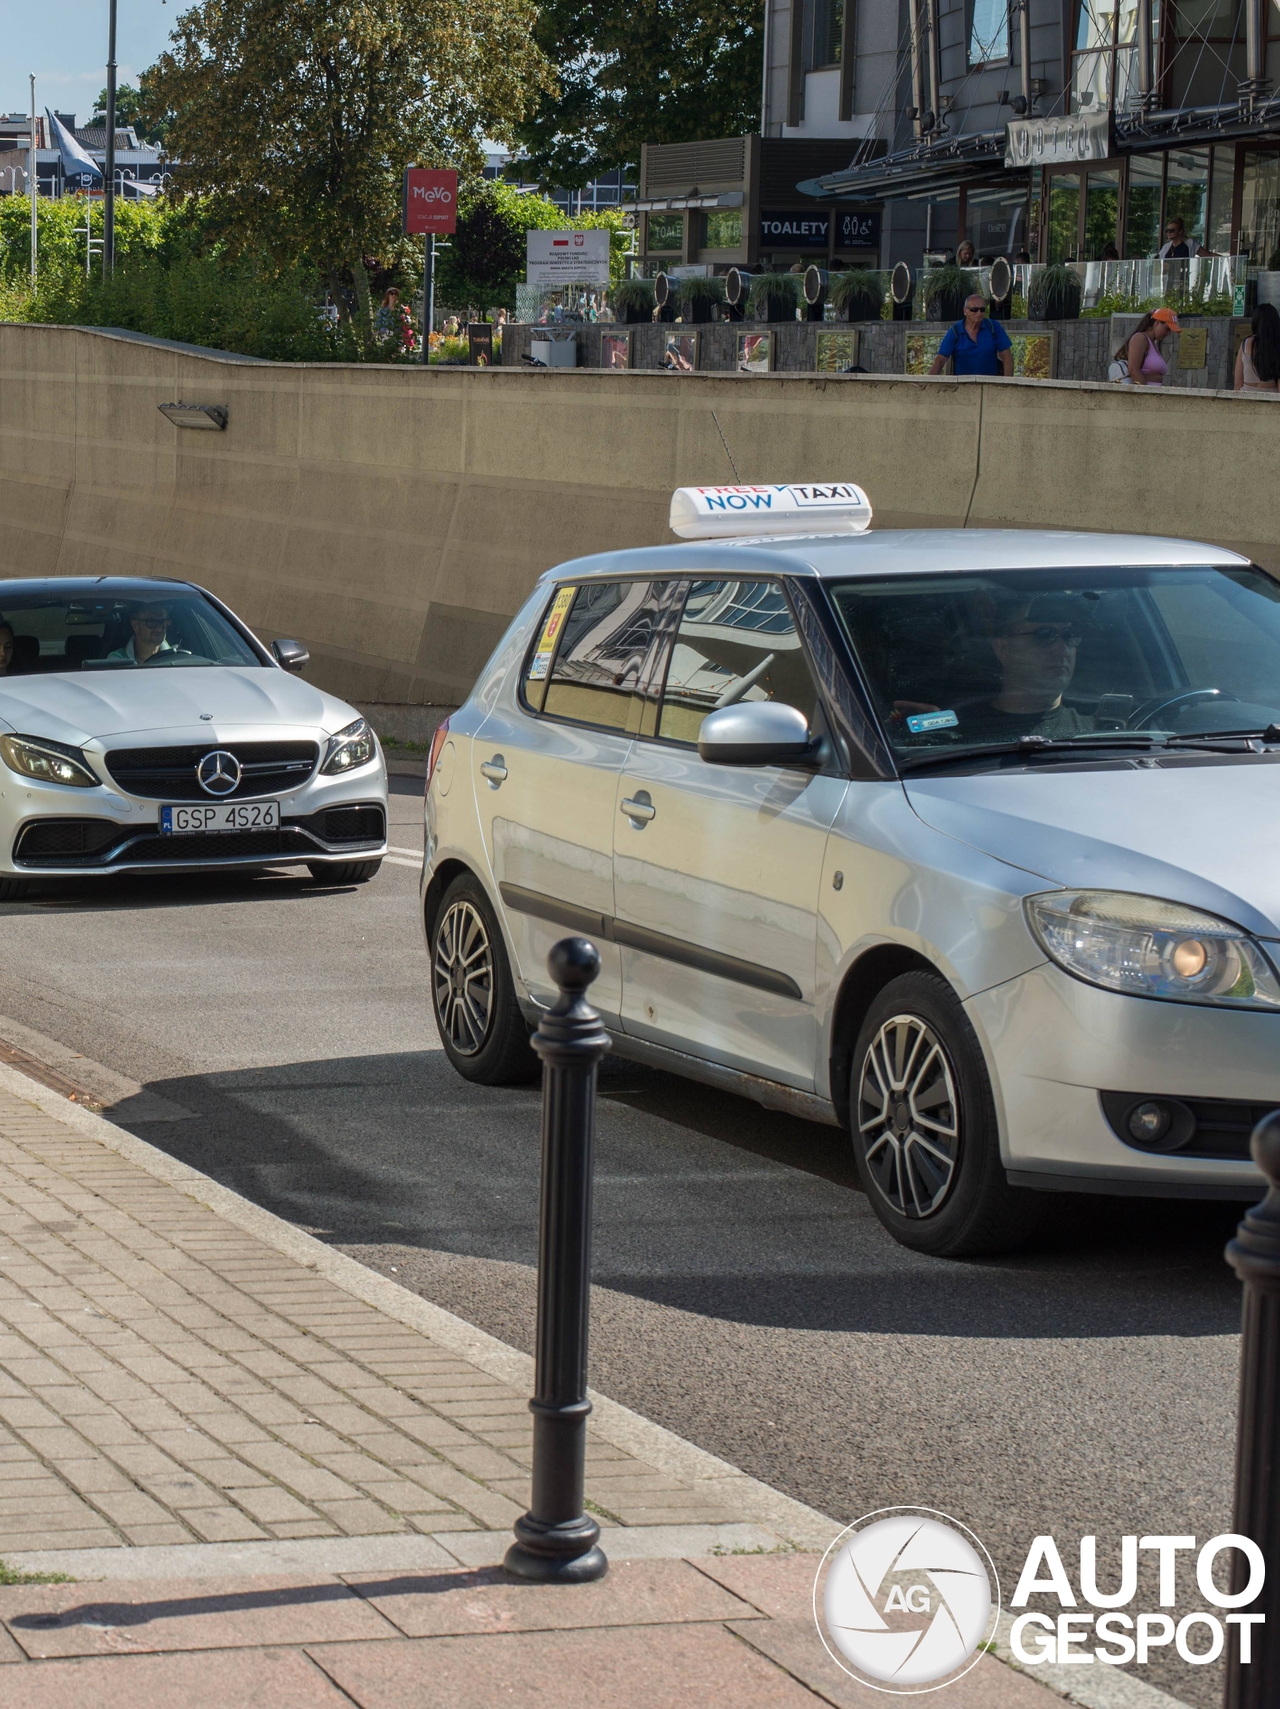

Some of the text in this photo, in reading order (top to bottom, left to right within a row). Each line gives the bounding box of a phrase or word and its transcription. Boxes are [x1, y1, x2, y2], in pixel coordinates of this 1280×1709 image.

[1019, 122, 1090, 158] HOTEL
[761, 221, 829, 235] TOALETY
[794, 486, 853, 499] TAXI
[705, 494, 772, 510] NOW
[176, 805, 273, 830] GSP 4S26
